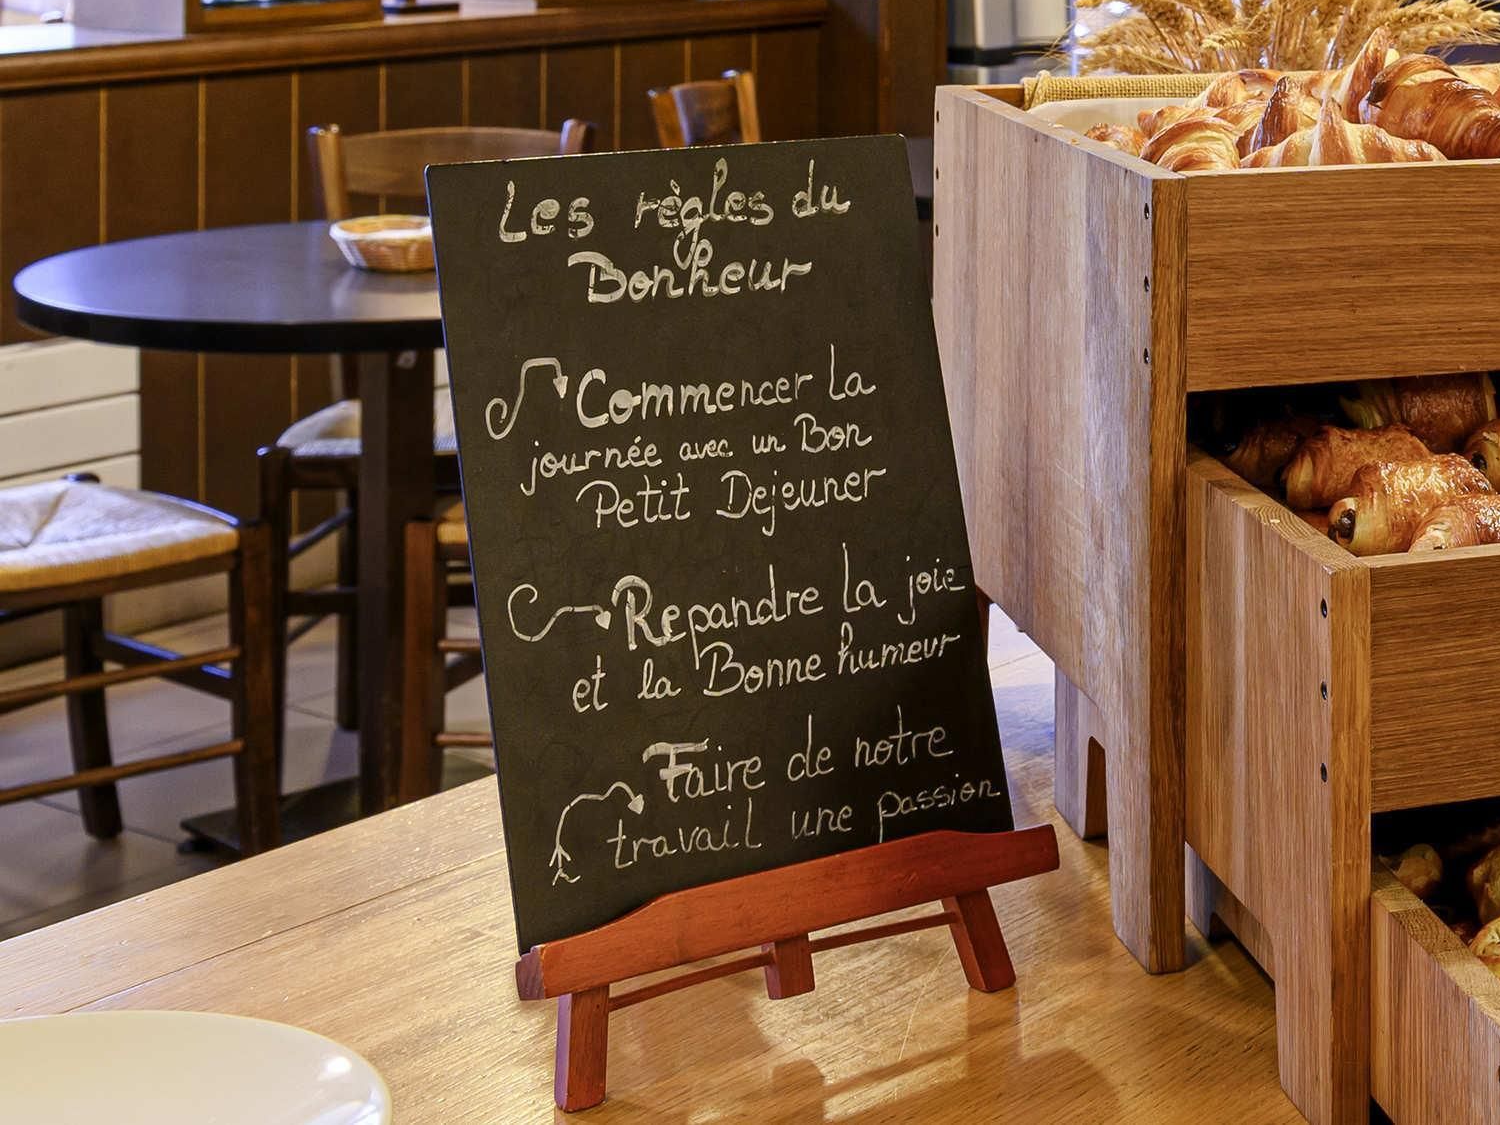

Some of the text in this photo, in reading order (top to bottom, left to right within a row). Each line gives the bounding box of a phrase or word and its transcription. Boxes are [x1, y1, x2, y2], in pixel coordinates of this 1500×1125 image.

[499, 157, 852, 270] Les règles du
[567, 236, 813, 305] Bonheur
[577, 367, 814, 429] Commencer
[520, 412, 873, 496] journée avec un Bon
[575, 467, 887, 537] Petit Dejeuner
[611, 564, 824, 670] Repandre
[897, 557, 967, 625] joie
[571, 621, 961, 714] et la Bonne humeur
[642, 704, 954, 804] Faire de notre
[606, 773, 1000, 871] travail une passion
